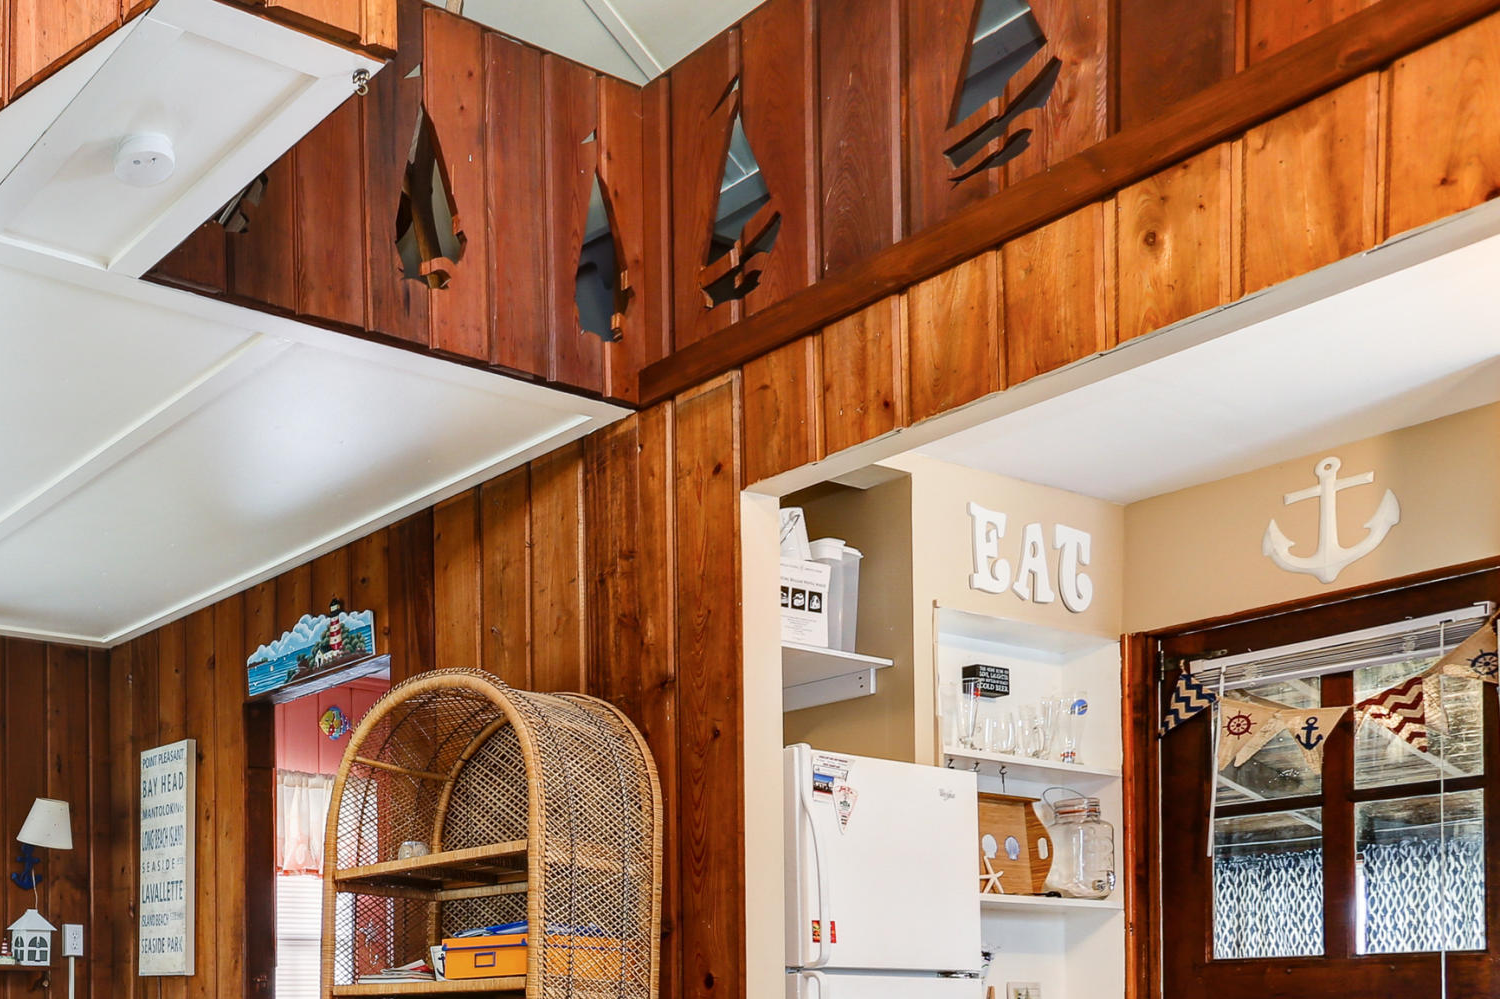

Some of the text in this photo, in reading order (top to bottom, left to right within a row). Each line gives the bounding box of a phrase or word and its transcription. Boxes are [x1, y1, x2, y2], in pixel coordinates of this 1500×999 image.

[967, 501, 1093, 613] EAT
[980, 682, 995, 690] COLD
[995, 684, 1009, 692] BEER
[143, 748, 185, 769] POINT PLEASANT
[142, 771, 184, 798] BAY HEAD
[142, 802, 184, 820] MANTOLOKING
[142, 824, 184, 851] LONG BEACH ISLAND
[142, 857, 175, 873] SEASIDE
[141, 880, 183, 904] LAVALLETTE
[156, 913, 169, 926] BEACH
[141, 936, 183, 953] SEASIDE PARK
